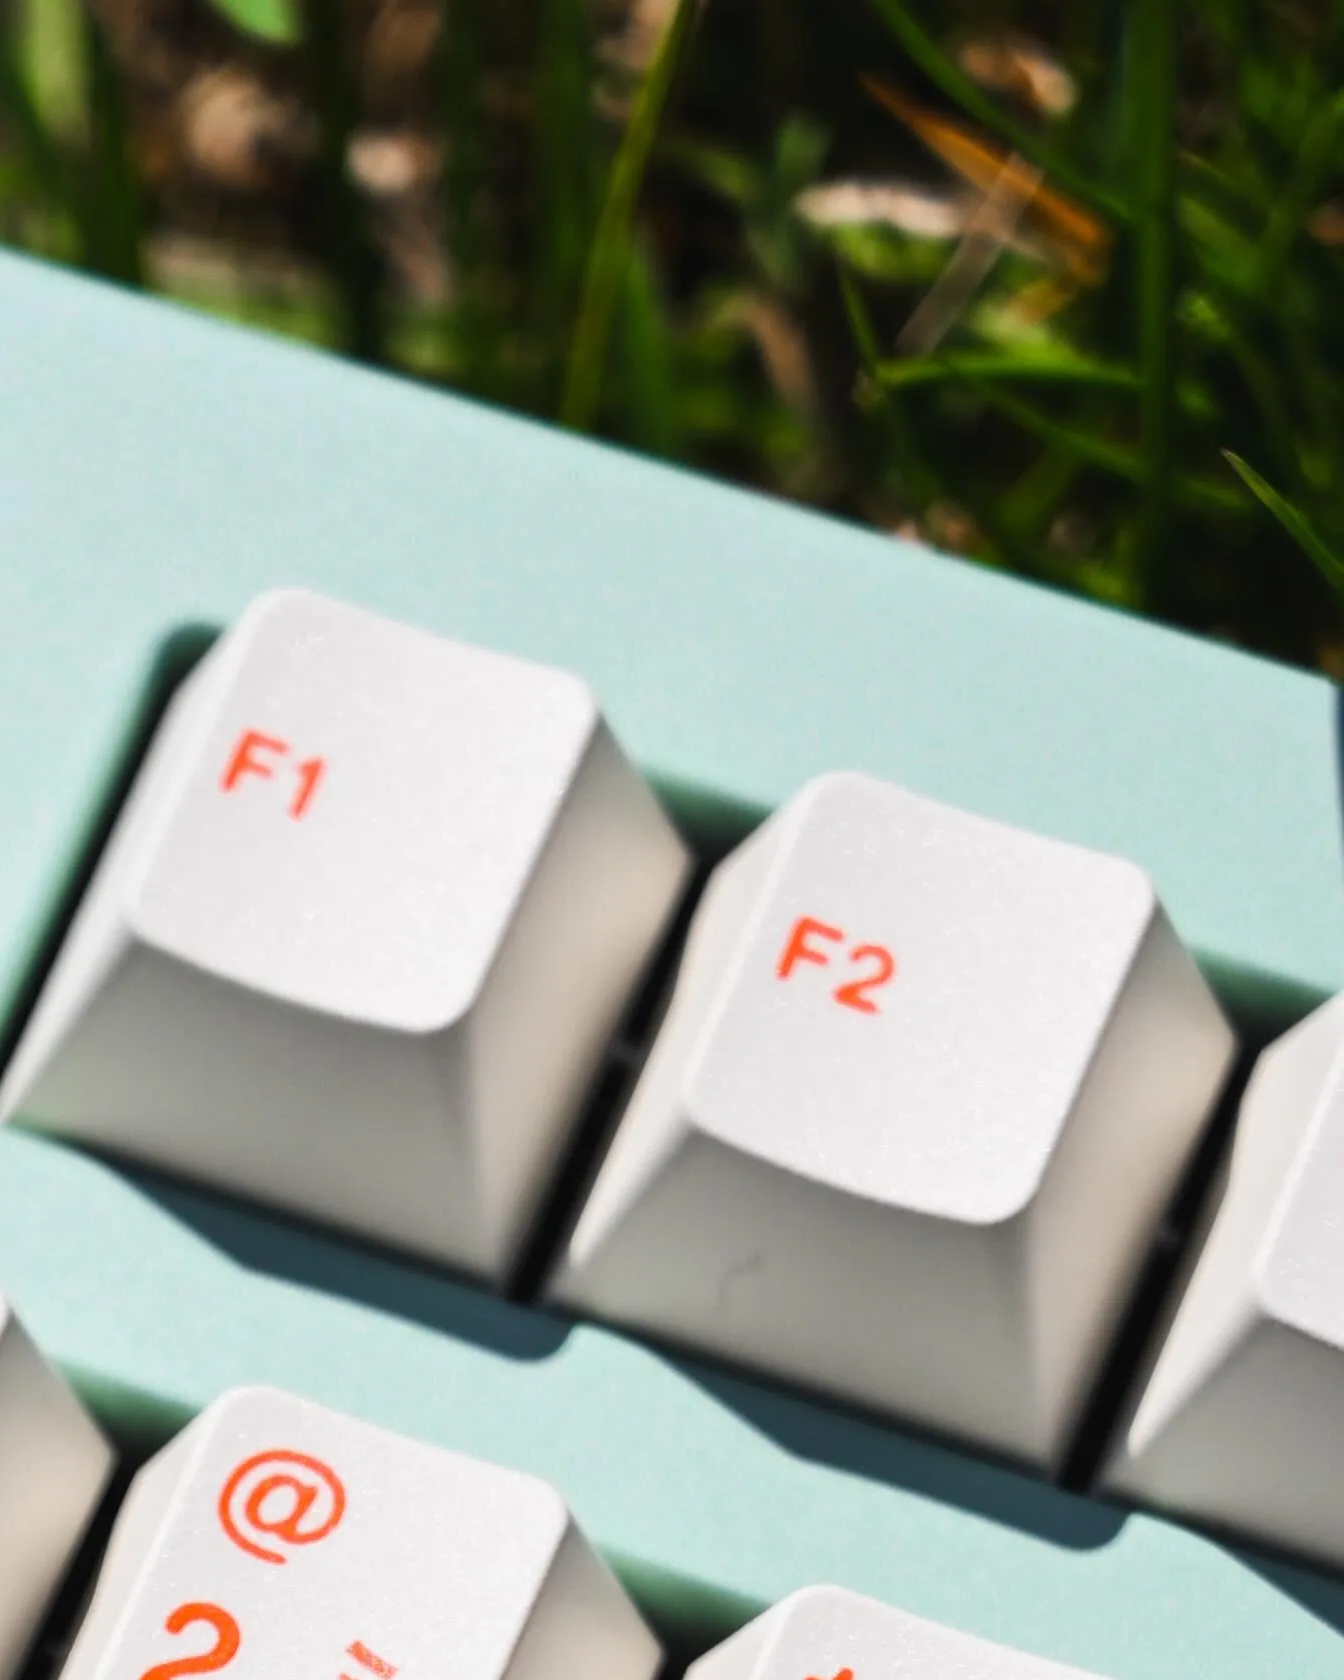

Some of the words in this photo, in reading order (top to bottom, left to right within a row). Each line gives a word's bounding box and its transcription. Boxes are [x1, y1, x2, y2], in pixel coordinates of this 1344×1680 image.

[220, 728, 326, 820] F1
[775, 914, 897, 1015] F2
[215, 1447, 349, 1566] @
